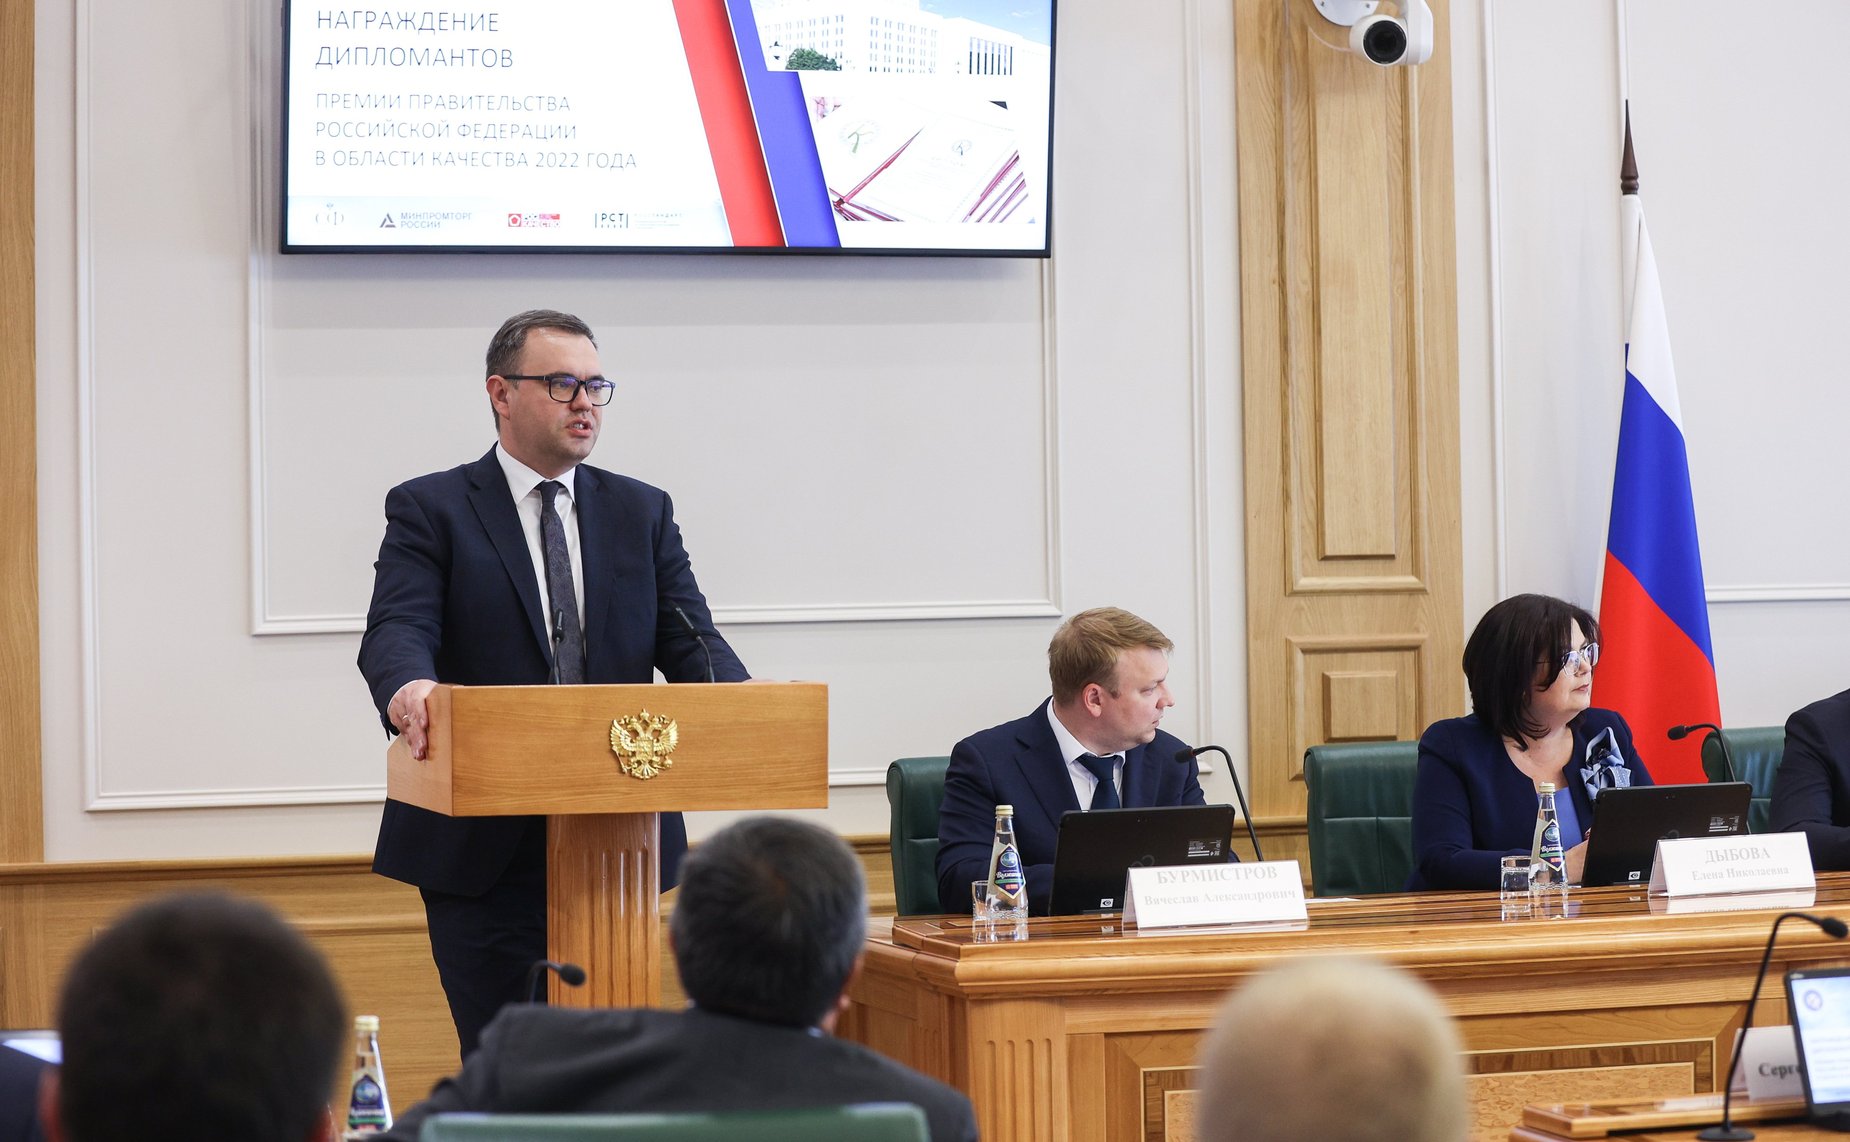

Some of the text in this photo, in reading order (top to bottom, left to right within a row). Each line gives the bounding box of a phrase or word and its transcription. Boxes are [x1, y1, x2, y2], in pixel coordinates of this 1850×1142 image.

[318, 10, 499, 35] НАГРАЖДЕНИЕ
[315, 46, 513, 71] ДИПЛОМАНТОВ
[317, 93, 570, 111] ПРЕМИИ ПРАВИТЕЛЬСТВА
[316, 119, 575, 142] РОССИЙСКОЙ ФЕДЕРАЦИИ
[316, 150, 636, 170] В ОБЛАСТИ КАЧЕСТВА 2022 ГОДА
[399, 212, 472, 221] МИНПРОМТОРГ
[400, 220, 441, 229] РОССИИ
[1705, 847, 1771, 864] ДЫБОВА
[1156, 866, 1278, 885] БУРМИСТРОВ
[1692, 866, 1790, 881] Елена Николаевна
[1204, 890, 1296, 904] Александрович
